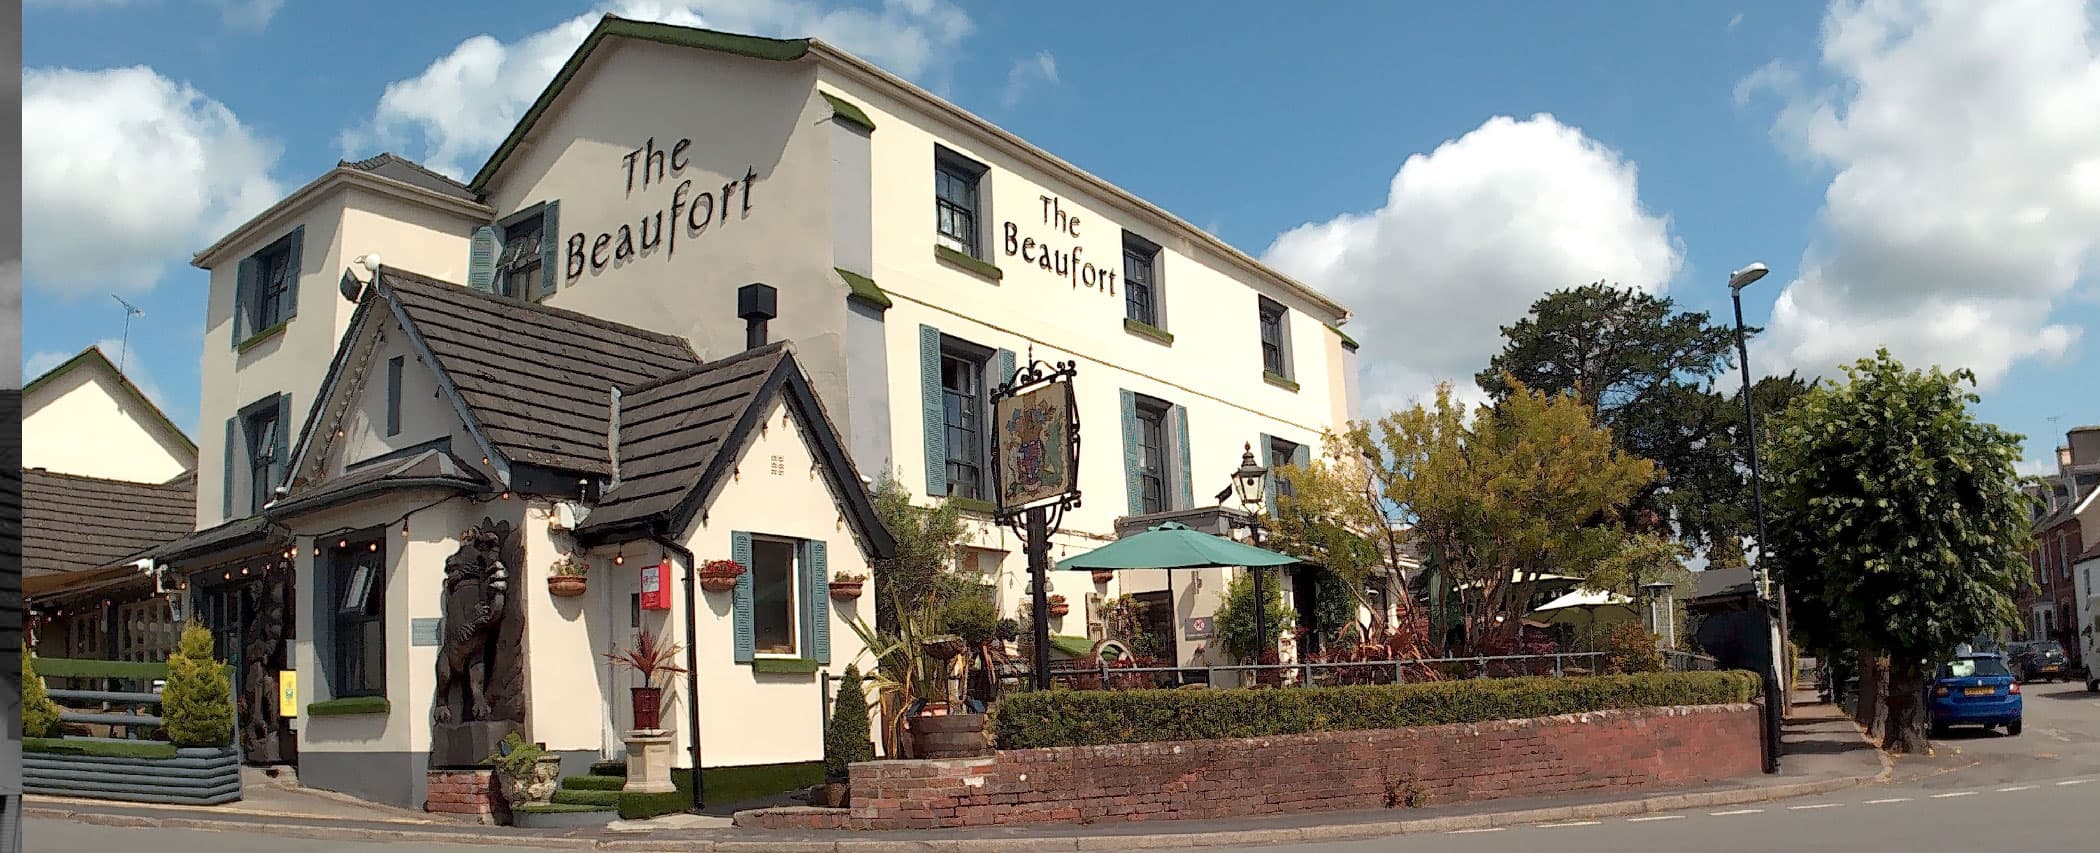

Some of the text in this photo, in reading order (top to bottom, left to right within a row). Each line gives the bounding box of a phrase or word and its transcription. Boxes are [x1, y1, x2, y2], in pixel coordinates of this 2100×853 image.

[623, 136, 692, 197] The
[567, 164, 758, 282] Beaufort
[1040, 194, 1080, 238] The
[1004, 221, 1116, 297] Beaufort
